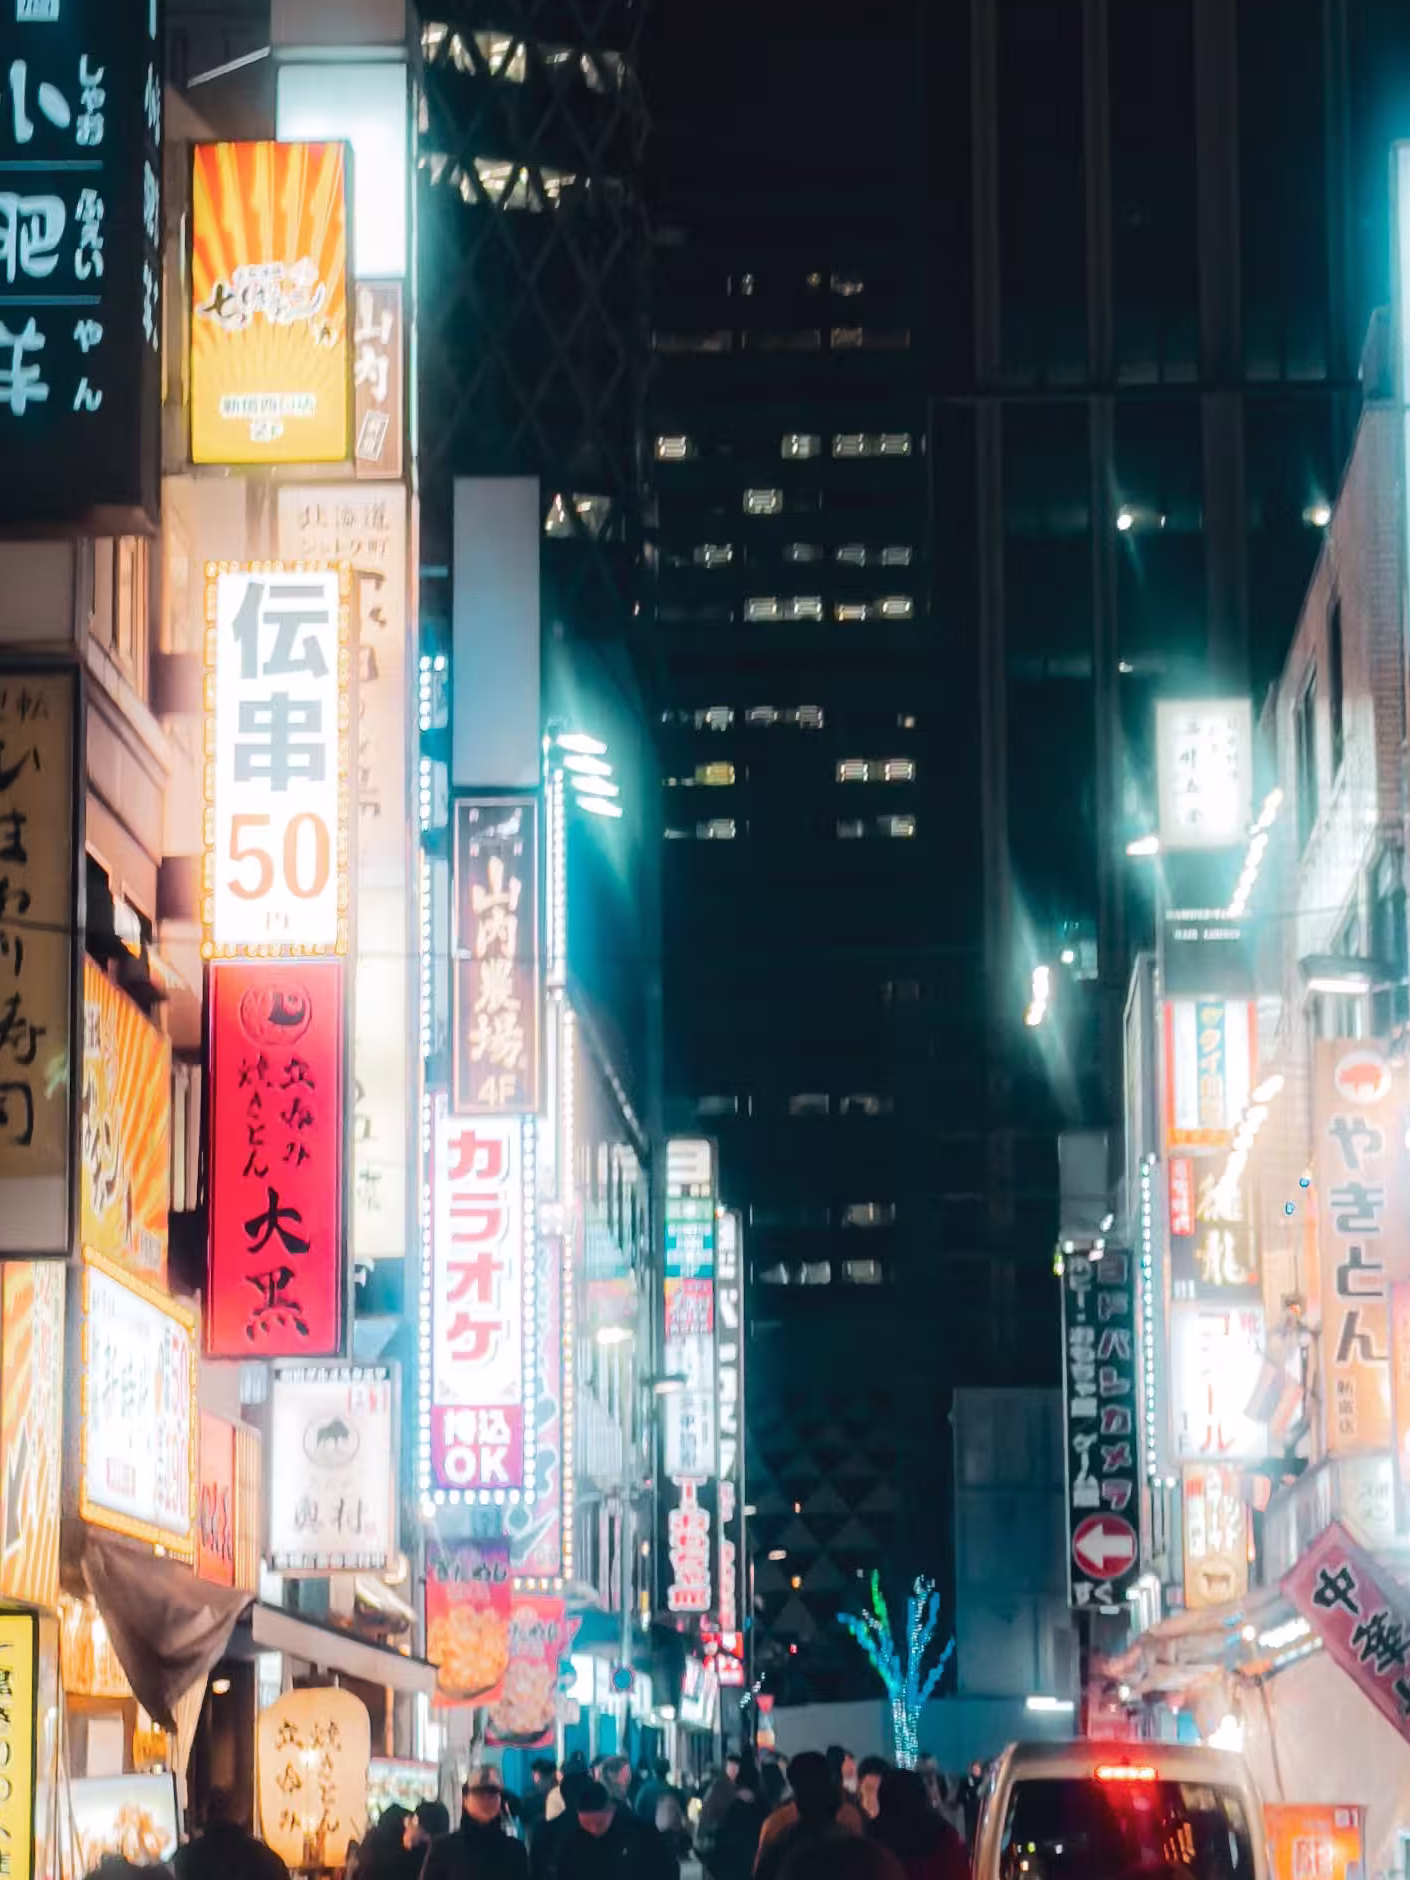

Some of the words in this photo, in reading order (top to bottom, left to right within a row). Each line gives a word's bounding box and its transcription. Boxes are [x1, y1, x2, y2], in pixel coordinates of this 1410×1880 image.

[231, 580, 331, 793] 伝串
[227, 811, 332, 901] 50
[478, 1072, 516, 1104] 4F
[242, 1185, 312, 1342] 大黒
[446, 1129, 506, 1362] カラオケ
[1328, 1113, 1390, 1365] やきとん
[443, 1448, 510, 1484] OK
